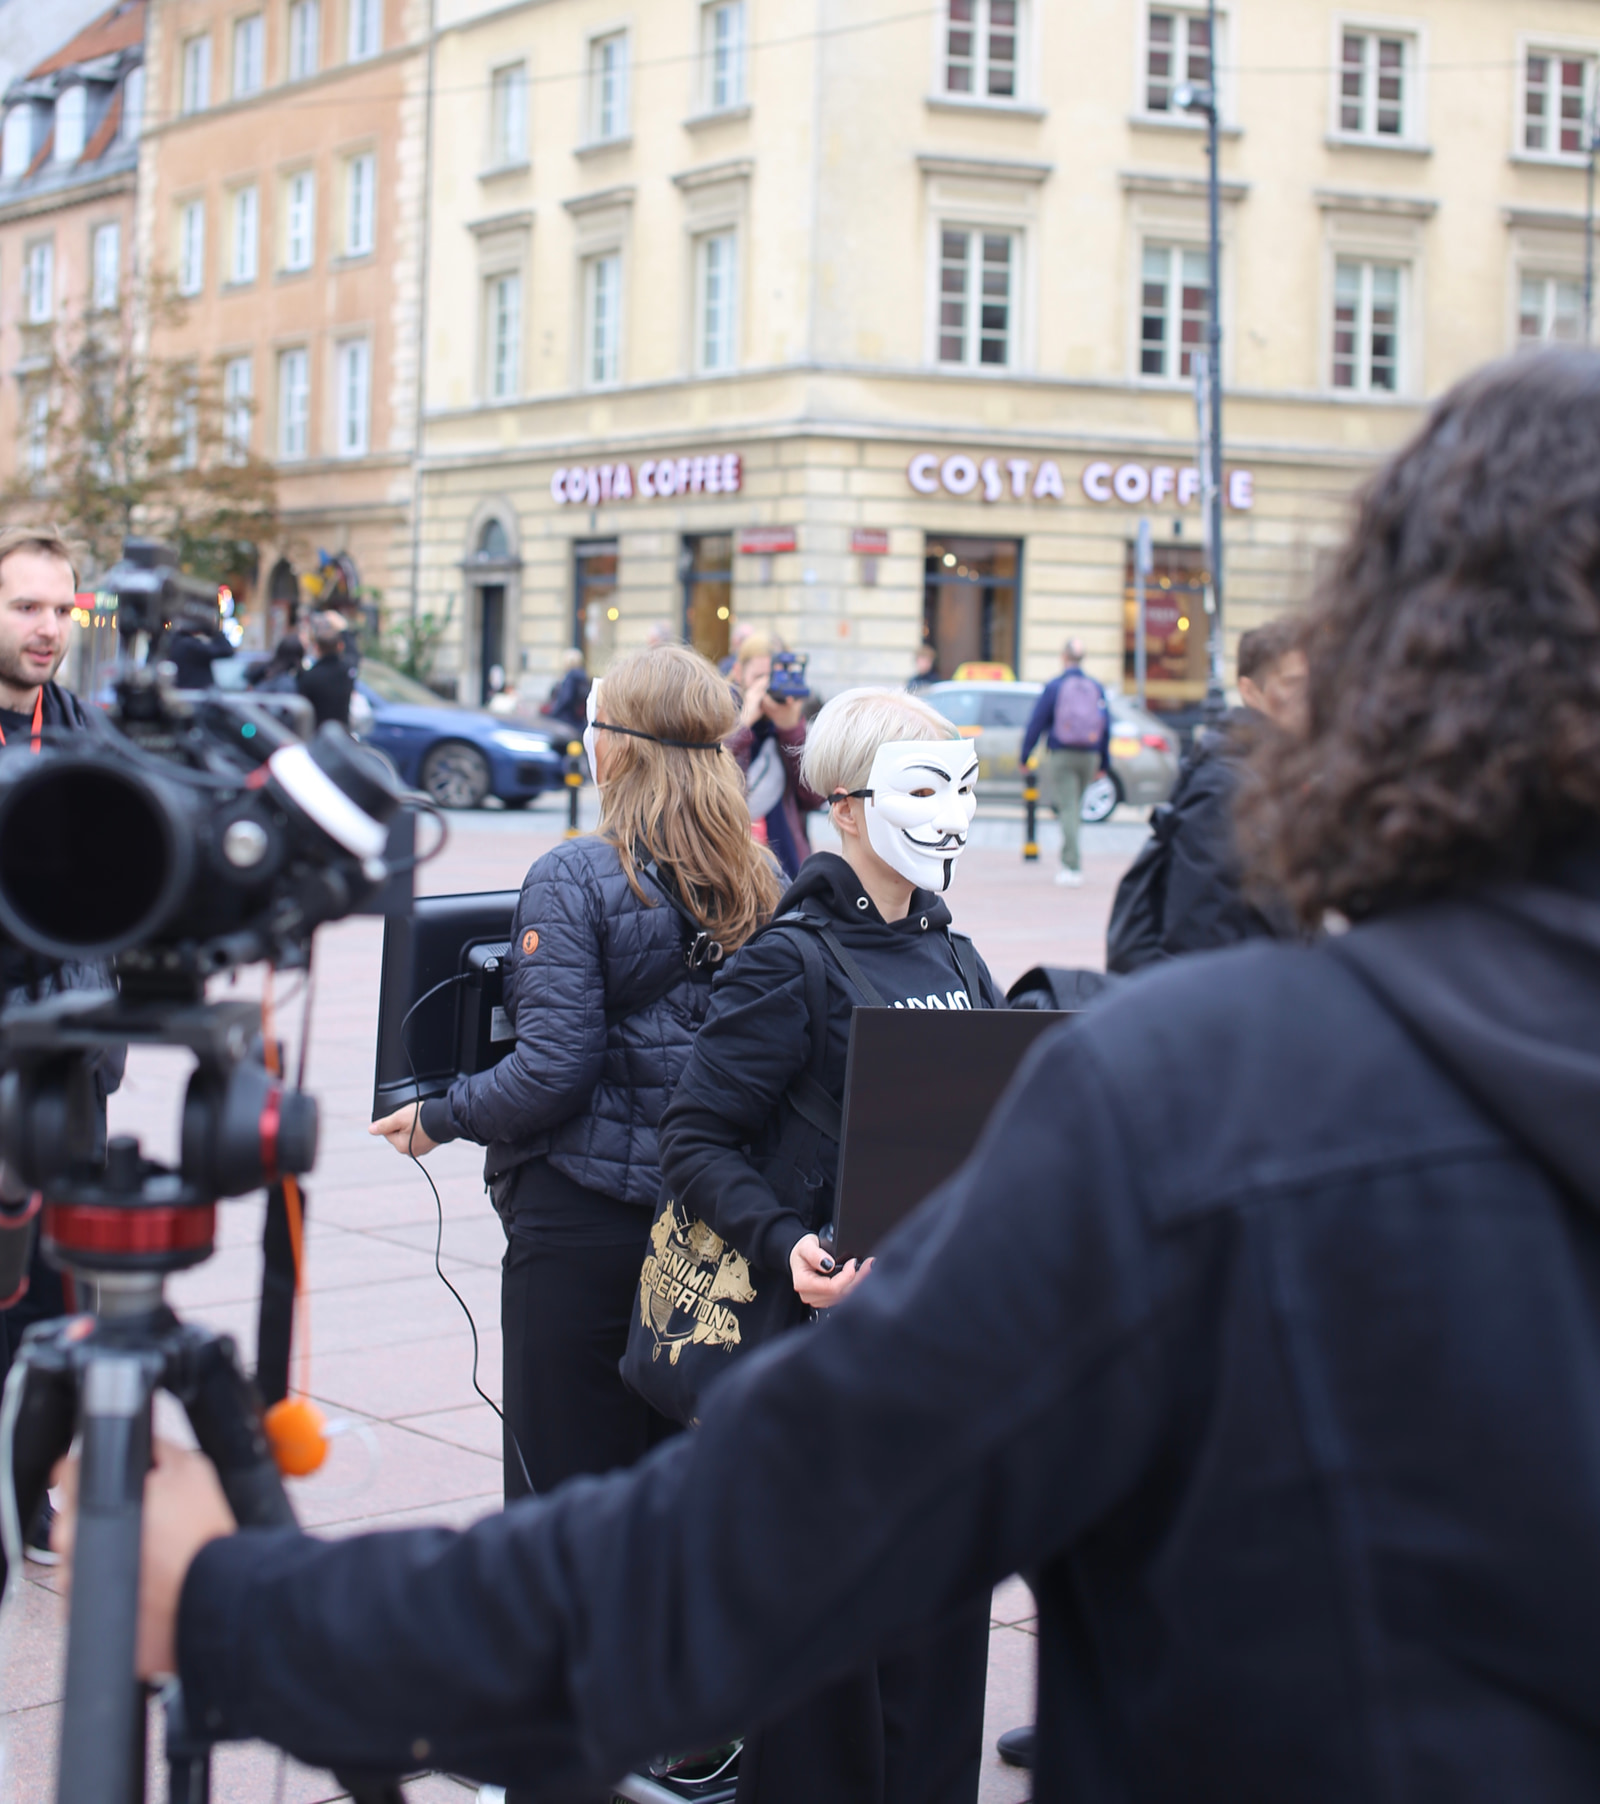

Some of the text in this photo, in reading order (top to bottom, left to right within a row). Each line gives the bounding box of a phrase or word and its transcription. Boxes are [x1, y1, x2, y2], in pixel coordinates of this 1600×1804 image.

[551, 453, 741, 506] COSTA COFFEE
[908, 453, 1254, 510] COSTA COFFE
[661, 1246, 714, 1298] ANIMA
